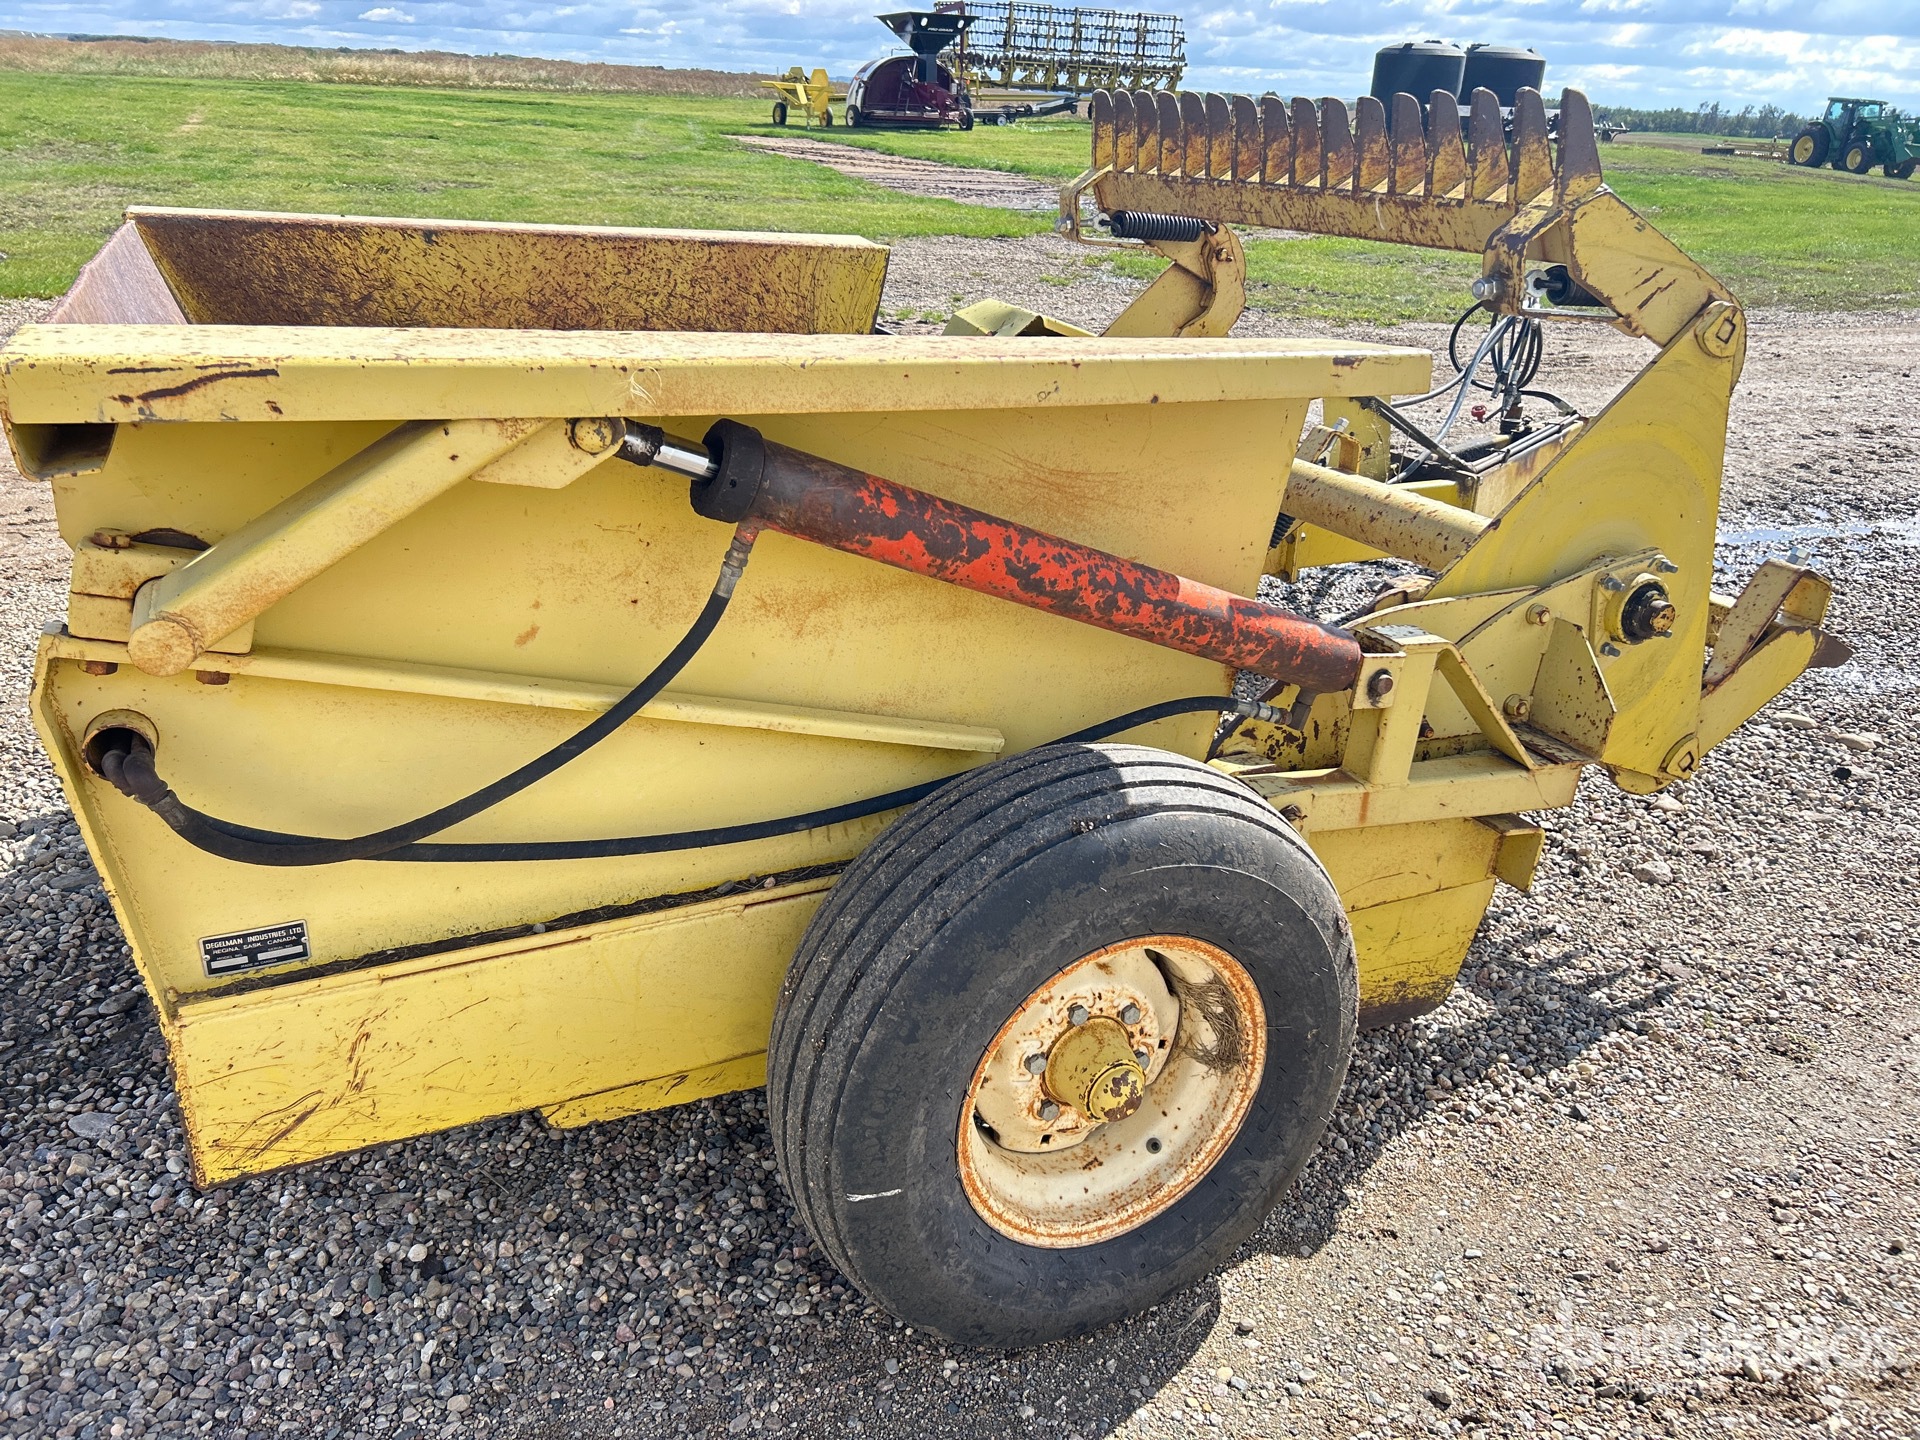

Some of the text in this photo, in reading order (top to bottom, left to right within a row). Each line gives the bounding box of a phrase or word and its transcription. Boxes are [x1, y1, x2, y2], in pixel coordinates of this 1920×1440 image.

[205, 938, 243, 950] DEGELMAN
[247, 930, 286, 942] INDUSTRIES
[267, 935, 298, 945] CANADA
